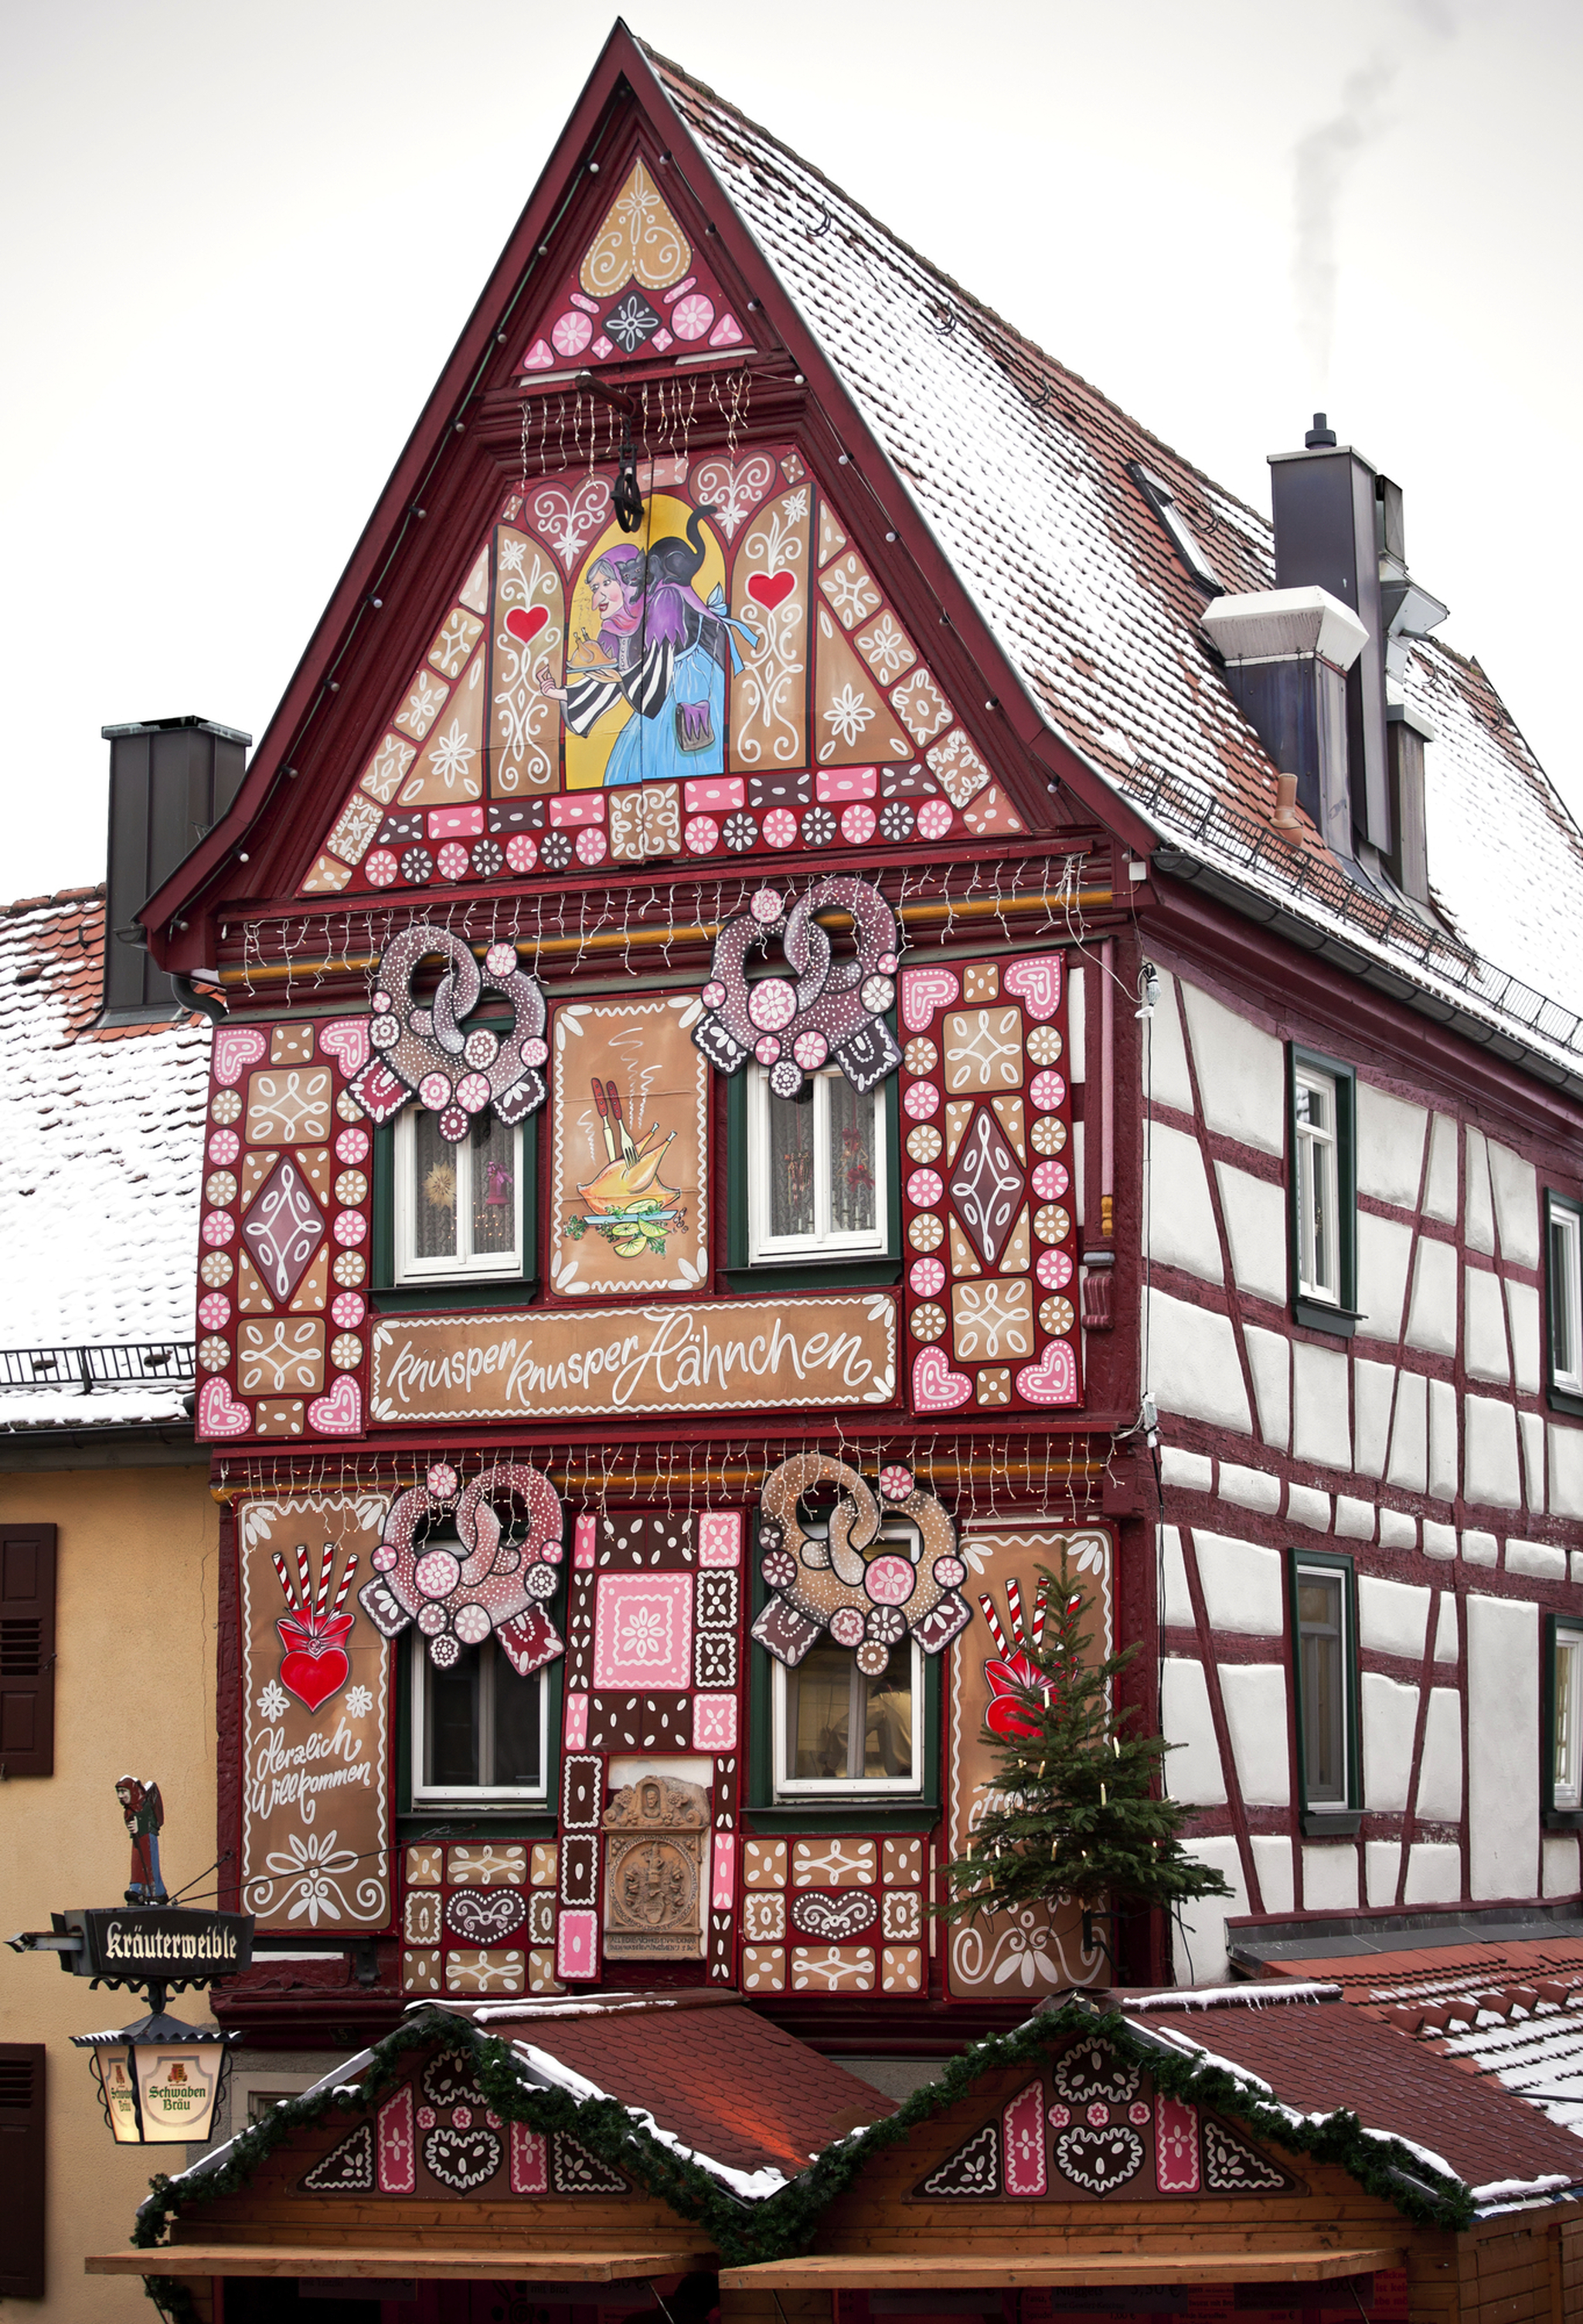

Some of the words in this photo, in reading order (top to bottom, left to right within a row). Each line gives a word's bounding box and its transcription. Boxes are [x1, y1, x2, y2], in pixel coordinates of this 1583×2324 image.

[611, 1312, 873, 1405] Hähnchen
[254, 1717, 363, 1781] Herzlich
[106, 1921, 237, 1959] Kräuterweible
[338, 2028, 348, 2040] 5
[148, 2085, 206, 2099] Schwaben
[162, 2098, 191, 2111] Bräu
